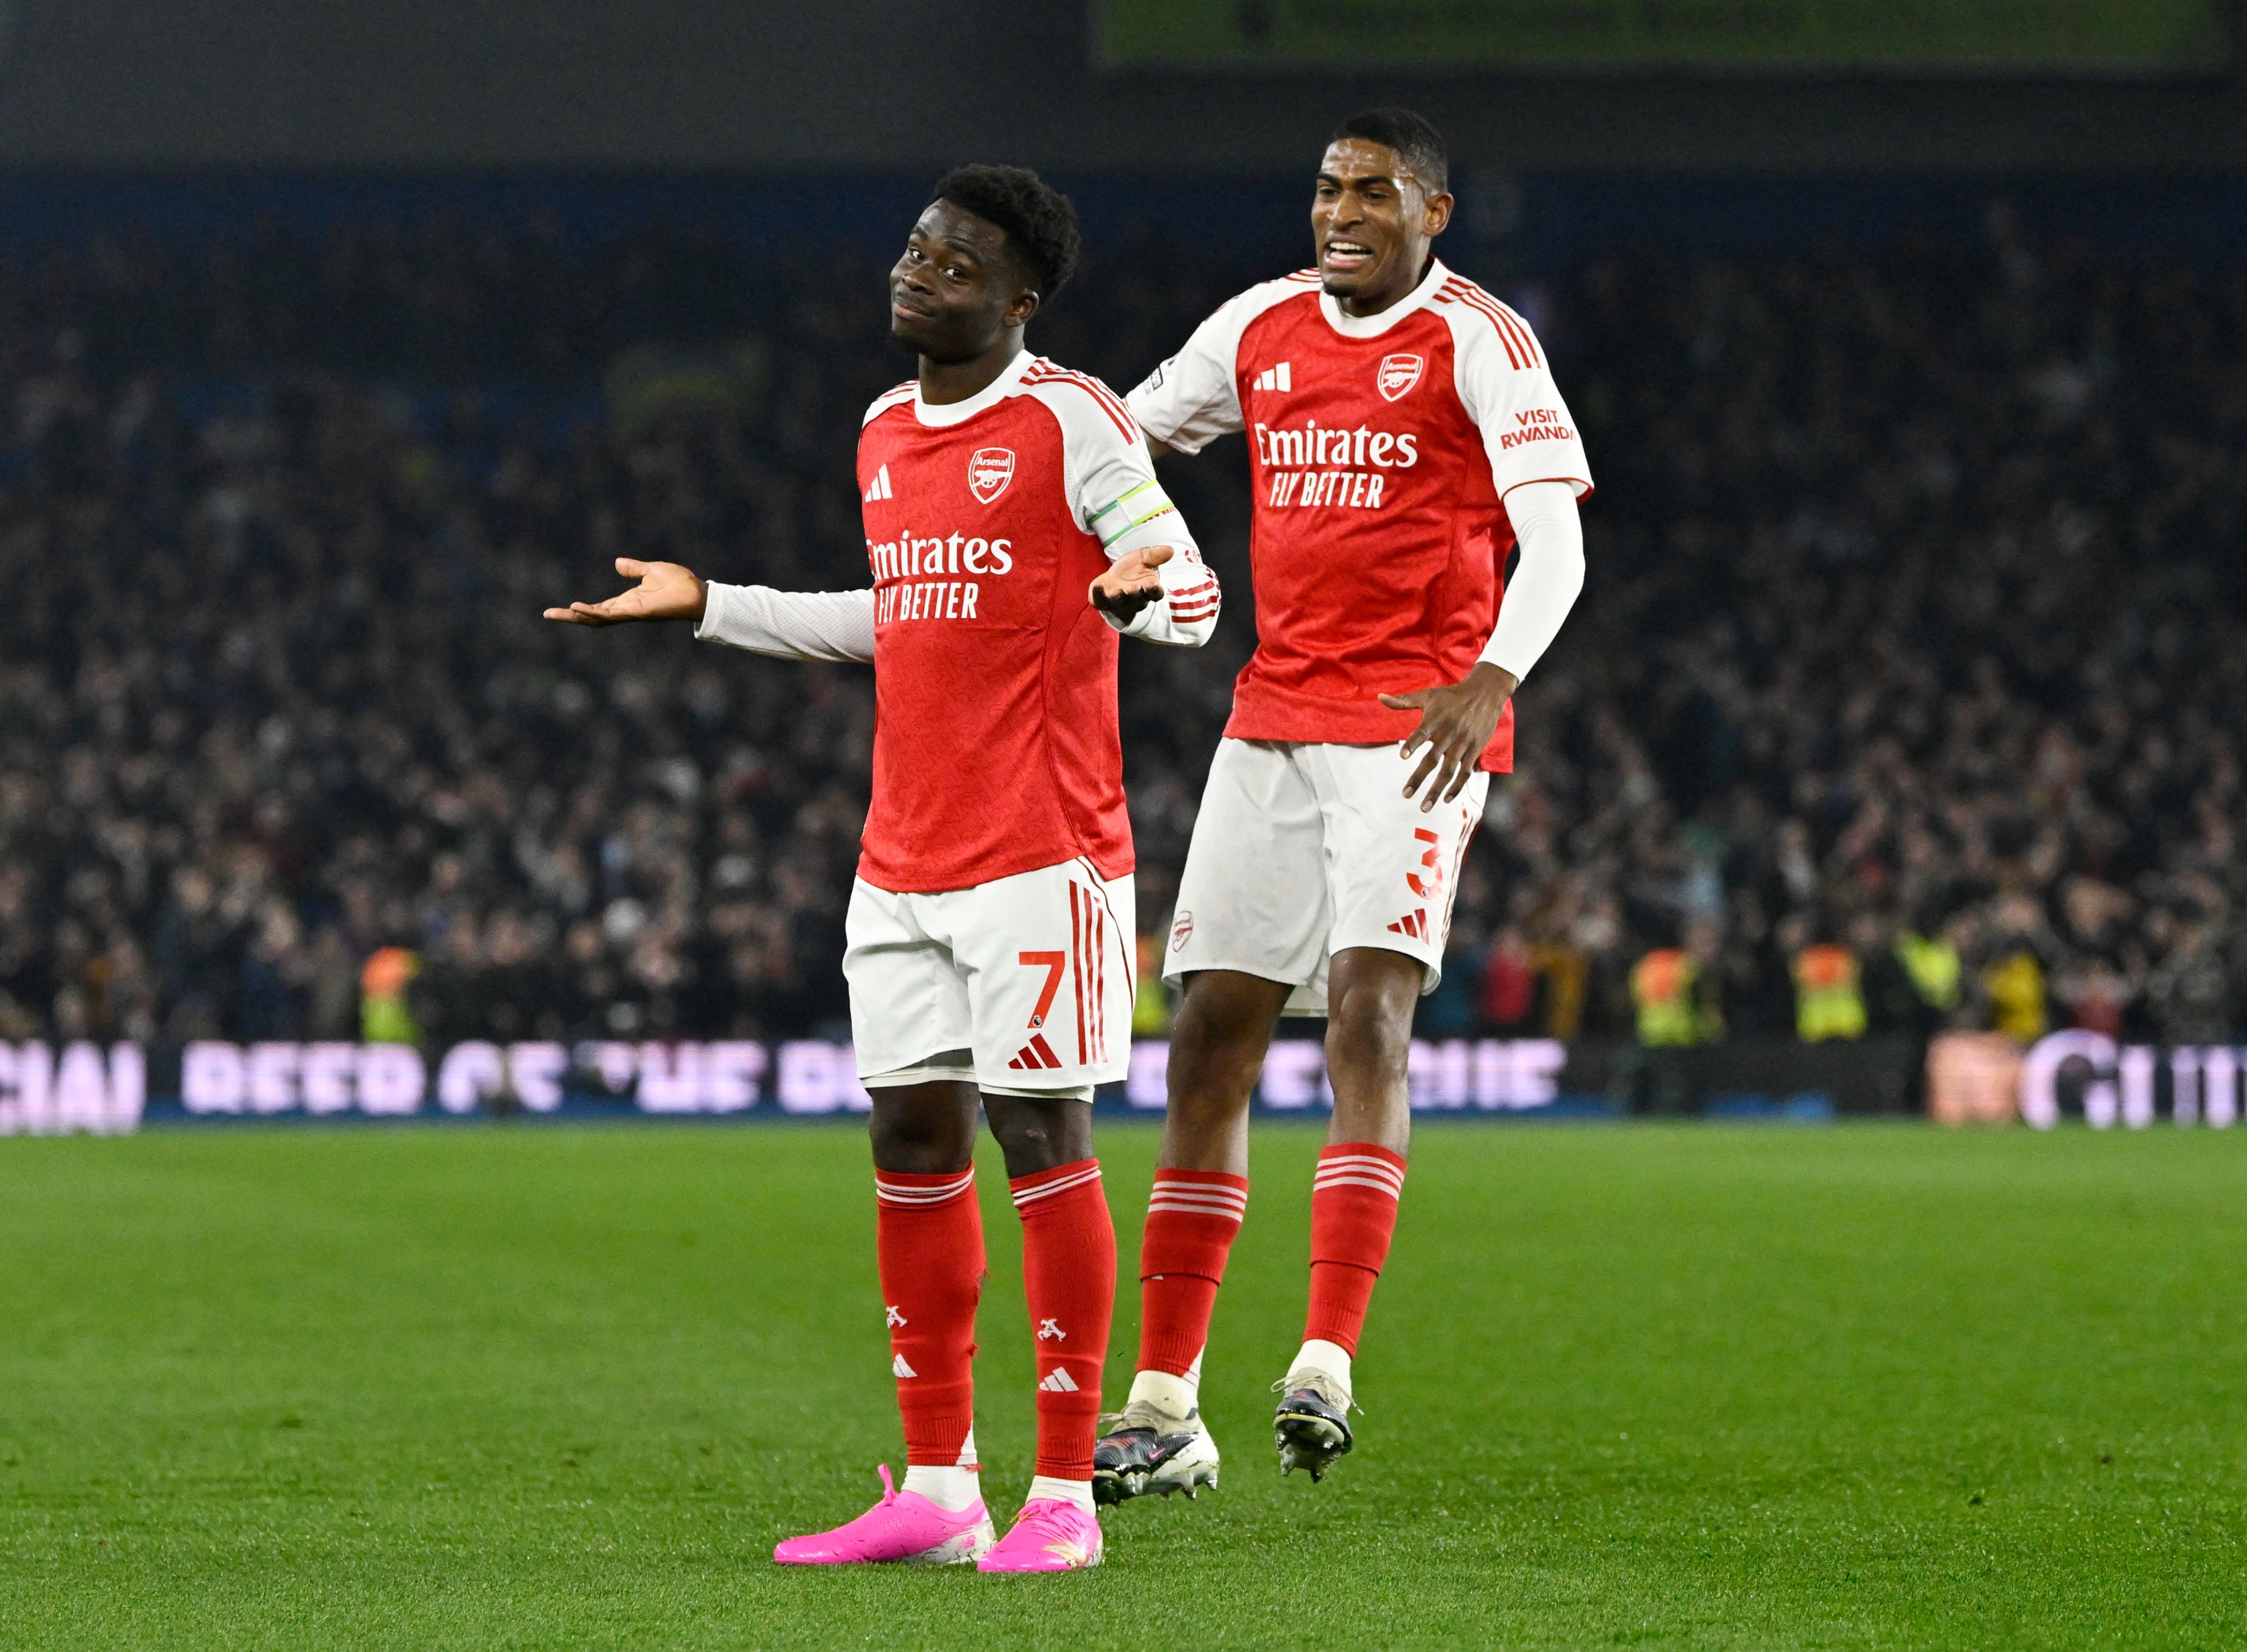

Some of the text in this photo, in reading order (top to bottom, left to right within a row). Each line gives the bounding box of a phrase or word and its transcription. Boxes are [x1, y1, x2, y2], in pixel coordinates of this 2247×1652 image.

[1515, 409, 1558, 426] VISIT
[976, 456, 1008, 467] Arsenal
[1254, 419, 1418, 468] Emirates
[1269, 471, 1384, 508] FLY BETTER
[878, 582, 979, 624] FLY BETTER
[1406, 827, 1445, 901] 3
[1019, 951, 1066, 1029] 7
